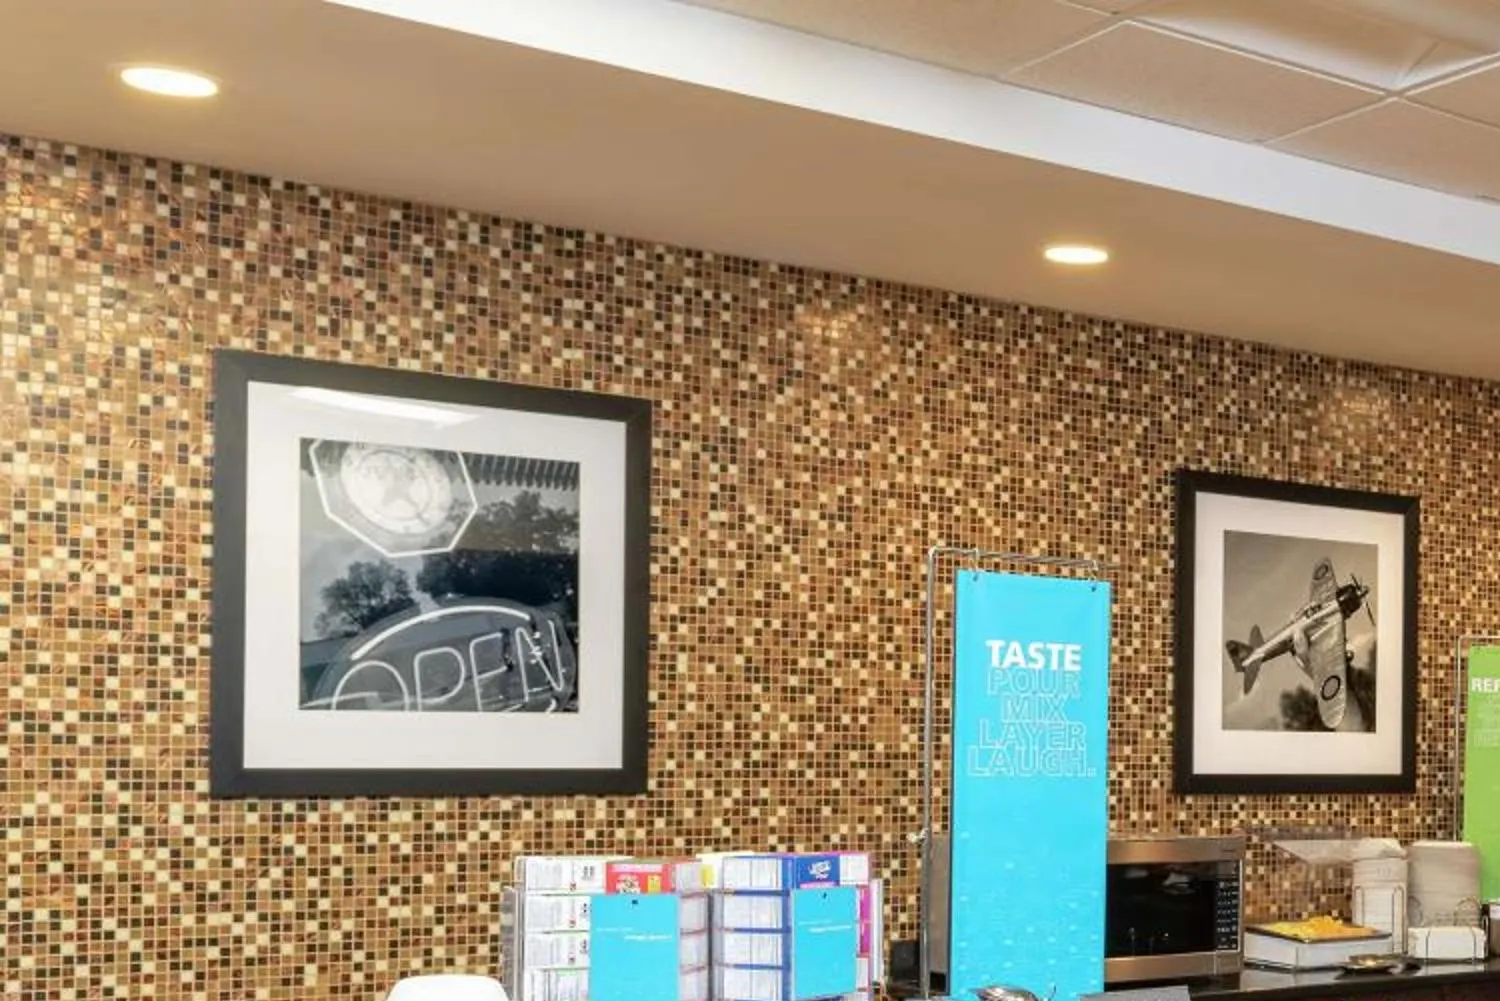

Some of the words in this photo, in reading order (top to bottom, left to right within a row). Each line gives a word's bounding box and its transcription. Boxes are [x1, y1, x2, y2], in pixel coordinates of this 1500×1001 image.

[985, 639, 1082, 671] TASTE
[987, 667, 1081, 696] POUR
[1001, 693, 1068, 722] MIX
[978, 719, 1087, 750] LAYER
[967, 745, 1097, 776] LAUGH.
